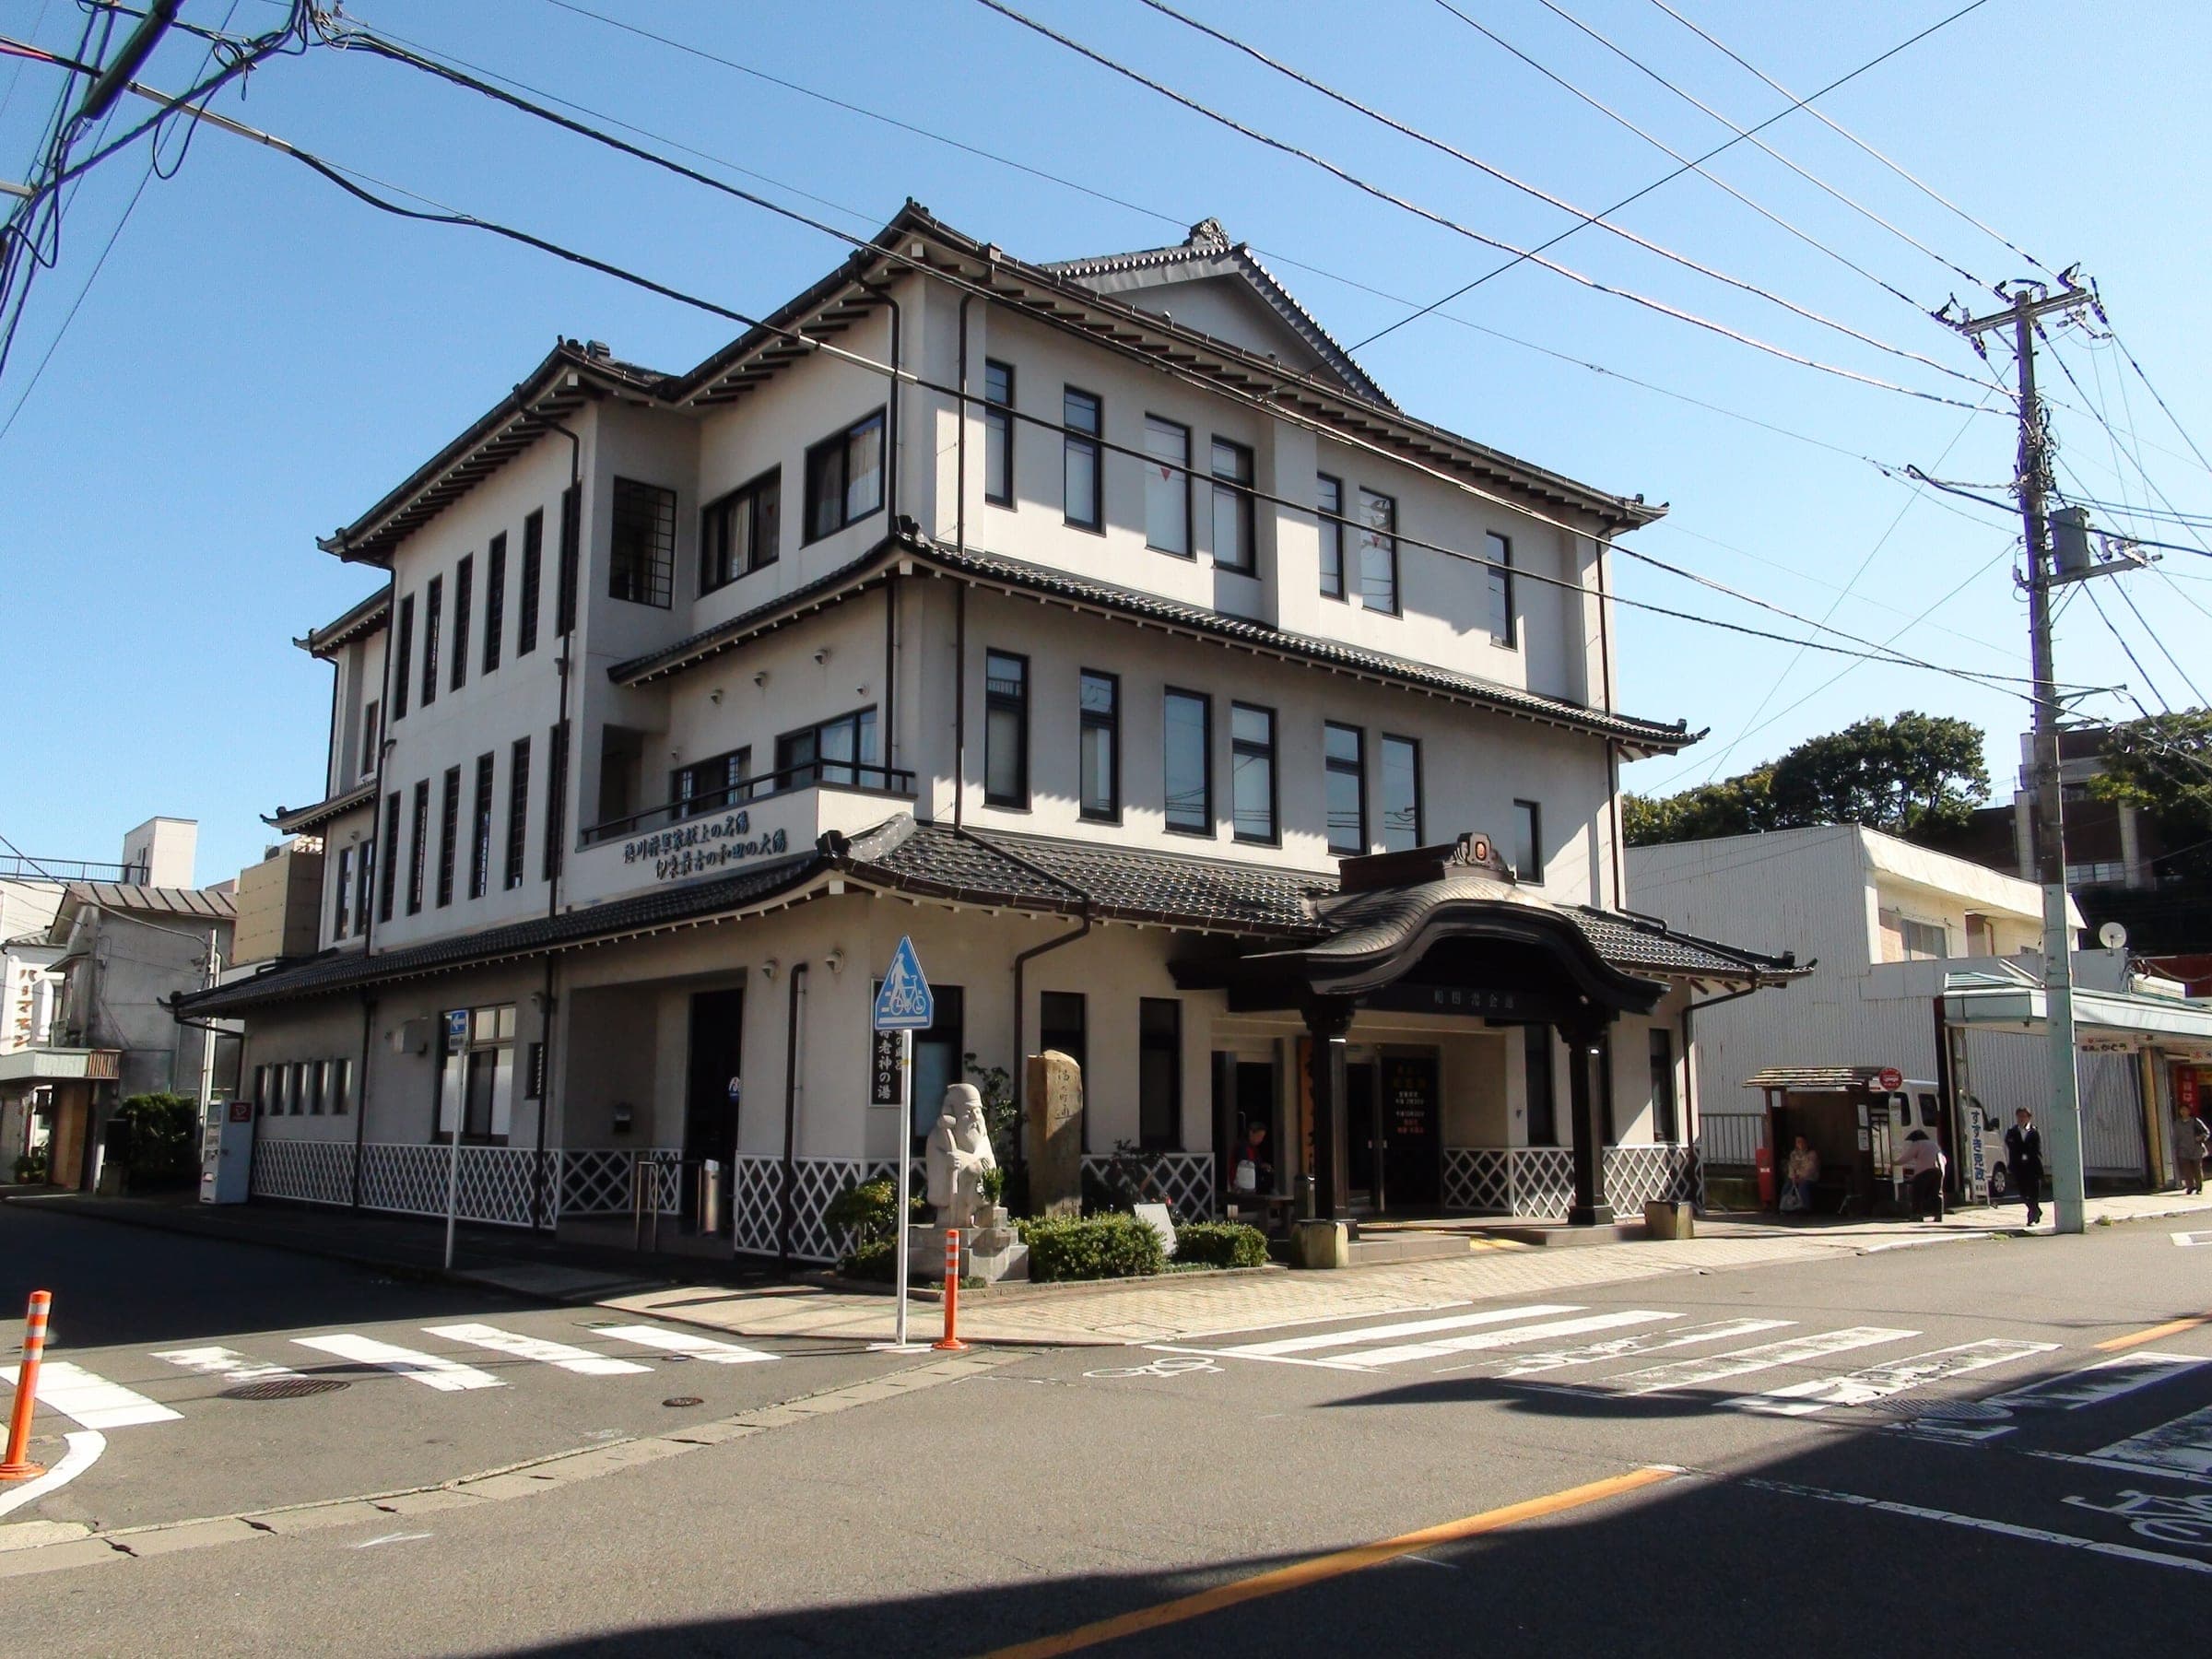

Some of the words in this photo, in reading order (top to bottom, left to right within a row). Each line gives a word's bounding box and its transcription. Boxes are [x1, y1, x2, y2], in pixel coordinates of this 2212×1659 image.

[655, 828, 788, 879] 伊東最古の和田の大湯
